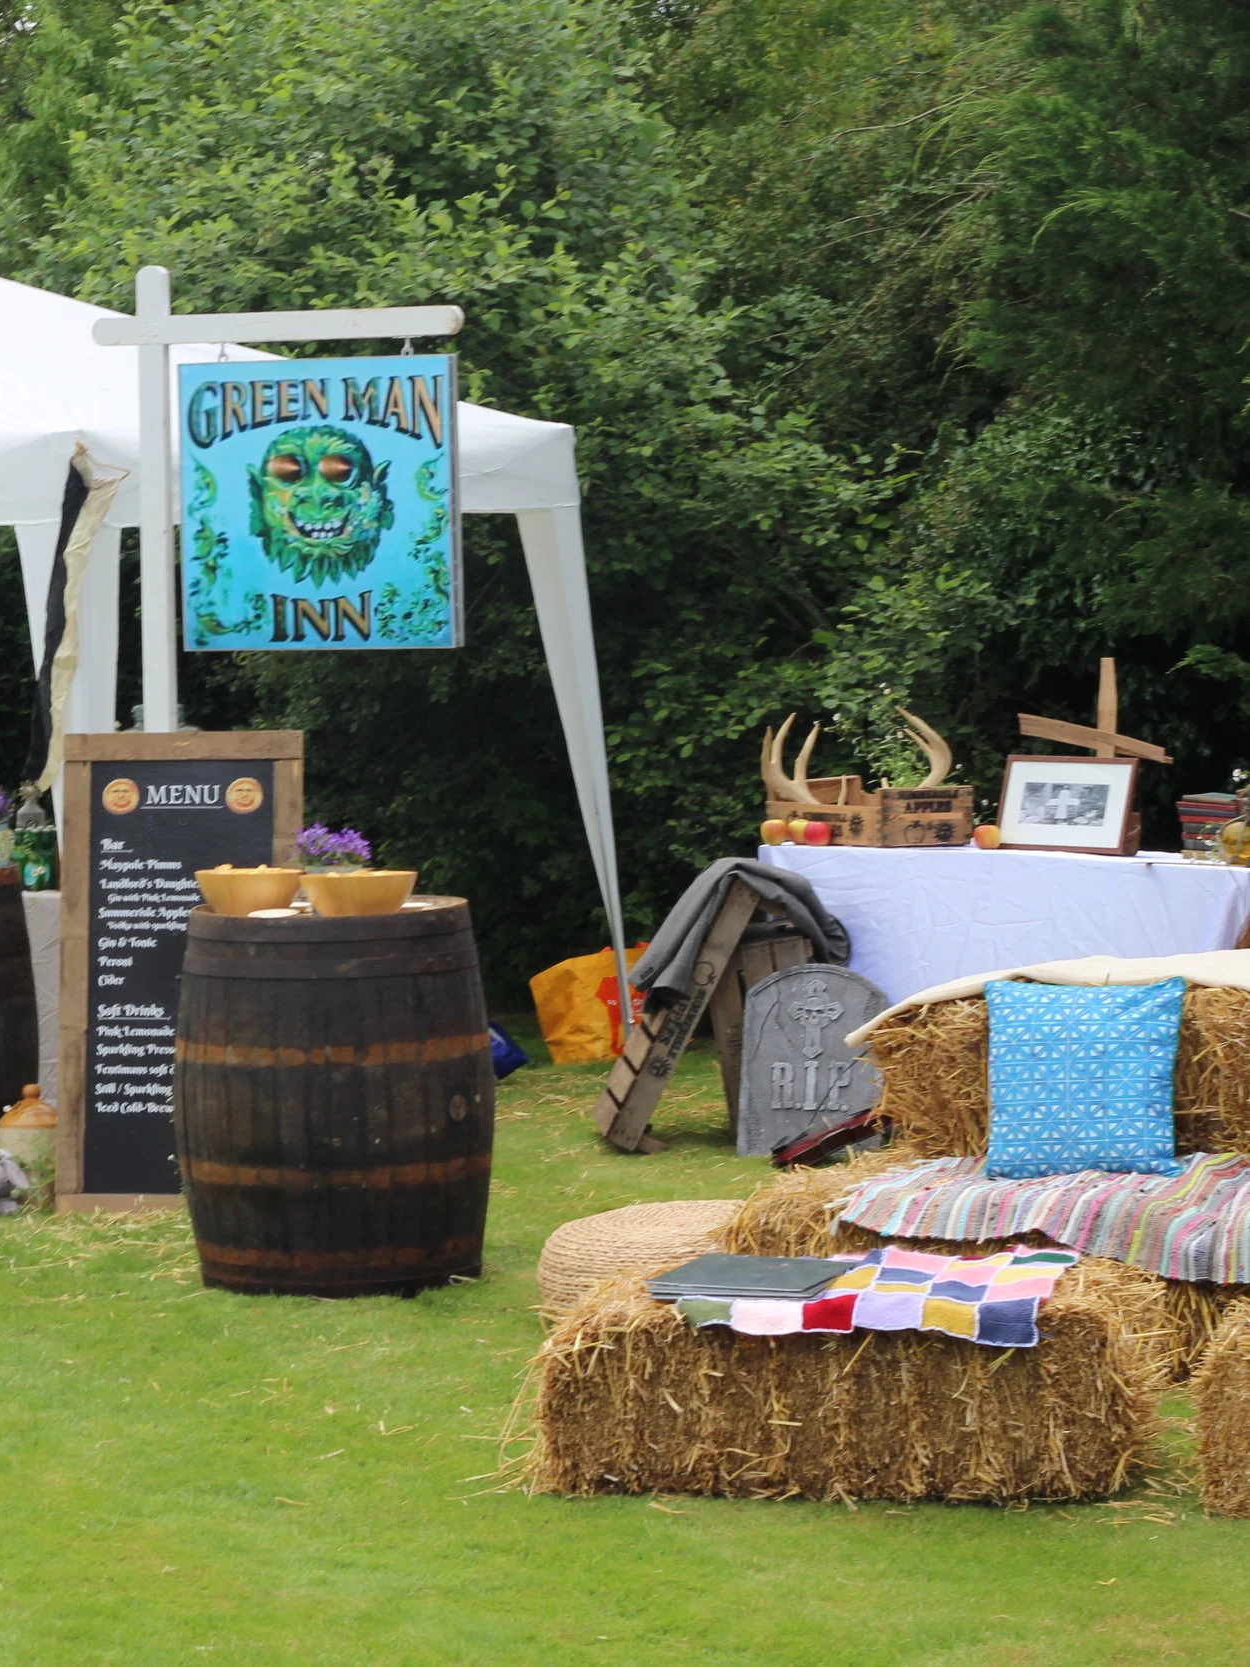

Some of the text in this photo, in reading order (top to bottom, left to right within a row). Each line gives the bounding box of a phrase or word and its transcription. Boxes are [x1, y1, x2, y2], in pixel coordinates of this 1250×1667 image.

[188, 374, 445, 450] GREEN MAN
[269, 589, 373, 643] INN
[146, 784, 222, 805] MENU
[100, 838, 126, 850] Bar
[99, 857, 182, 873] Maypole Pimms
[99, 877, 199, 891] Landlord's Daughte
[98, 907, 157, 919] Summerisle
[98, 936, 158, 951] Gin & Tonic
[97, 955, 133, 967] Peroni
[98, 973, 126, 987] Cider
[97, 1003, 165, 1019] Soft Drinks
[96, 1025, 175, 1038] Pink Lemonade
[96, 1043, 145, 1057] Sparkling
[94, 1063, 148, 1075] Fentimans
[149, 1063, 168, 1078] soft
[95, 1082, 116, 1095] Still
[124, 1082, 173, 1097] Sparkling
[95, 1101, 119, 1113] Iced
